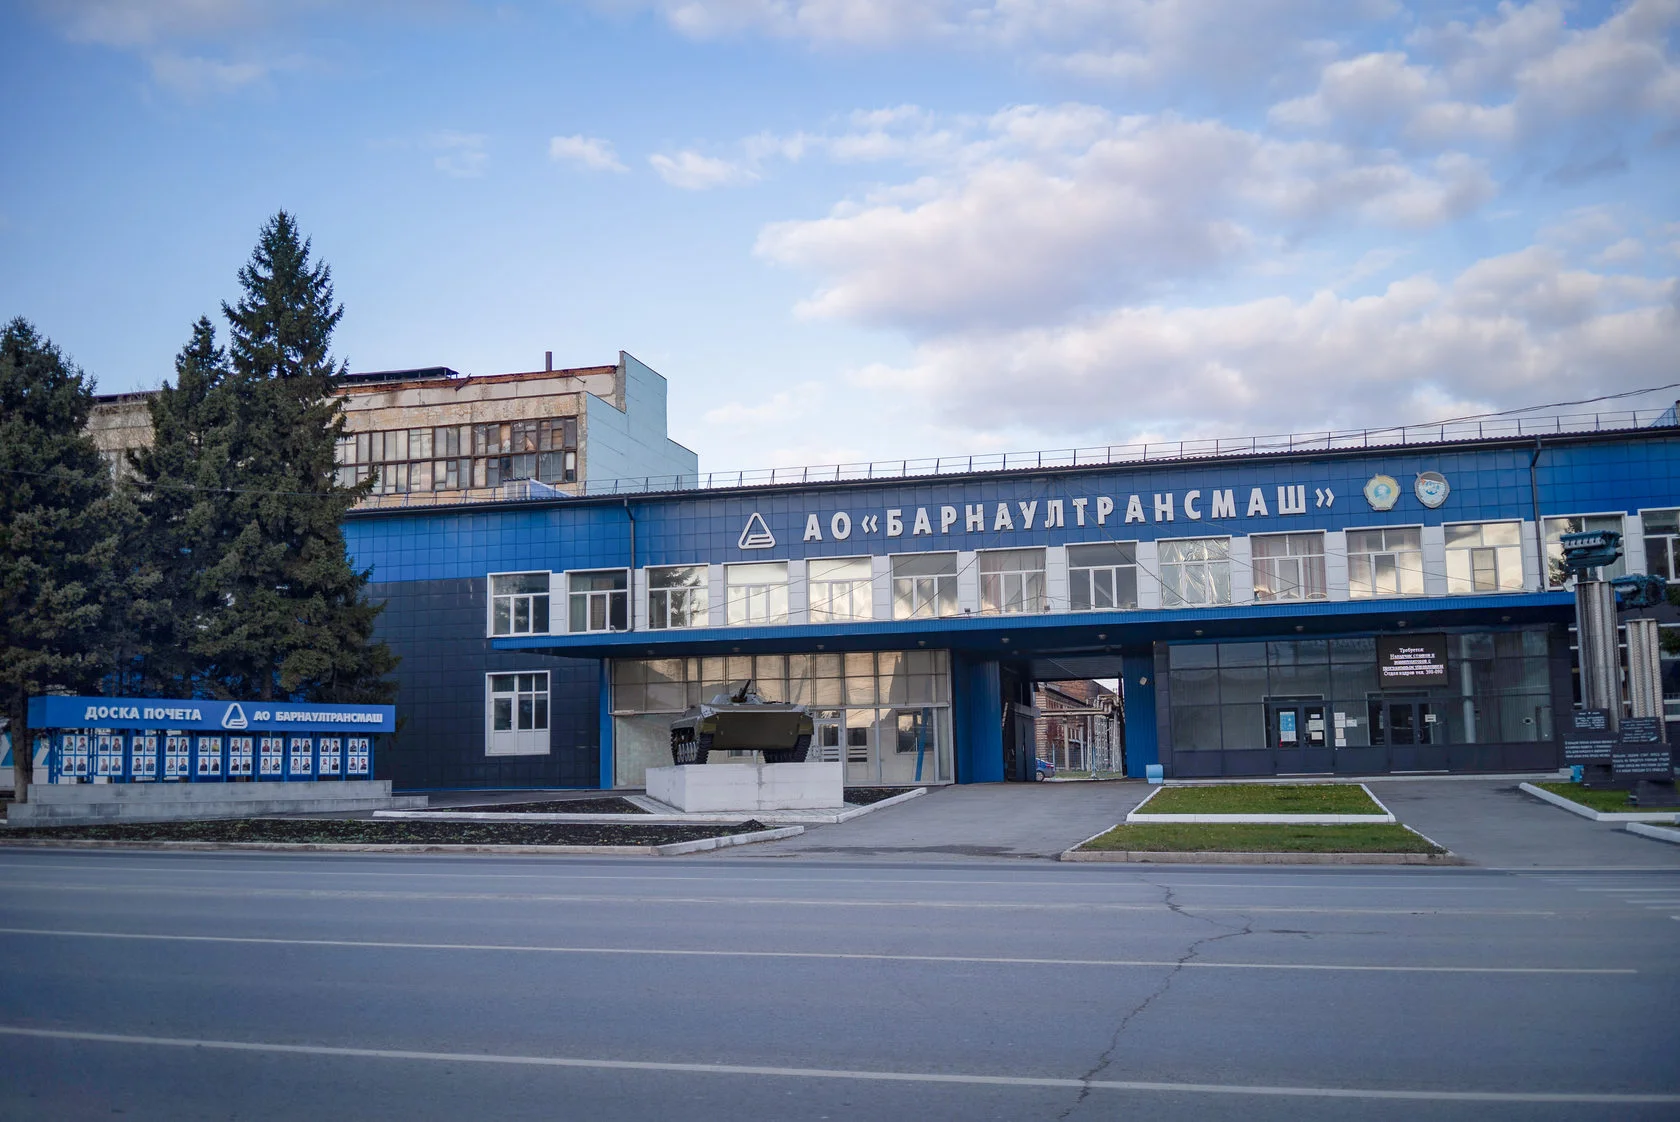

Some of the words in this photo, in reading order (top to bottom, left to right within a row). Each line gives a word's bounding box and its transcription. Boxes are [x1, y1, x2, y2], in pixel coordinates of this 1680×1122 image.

[803, 511, 852, 542] АО
[861, 485, 1335, 538] «БАРНАУЛТРАНСМАШ»
[84, 706, 140, 720] ДОСКА
[143, 707, 202, 721] ПОЧЕТА
[253, 710, 271, 721] АО
[275, 711, 383, 723] БАРНАУЛТРАНСМАШ
